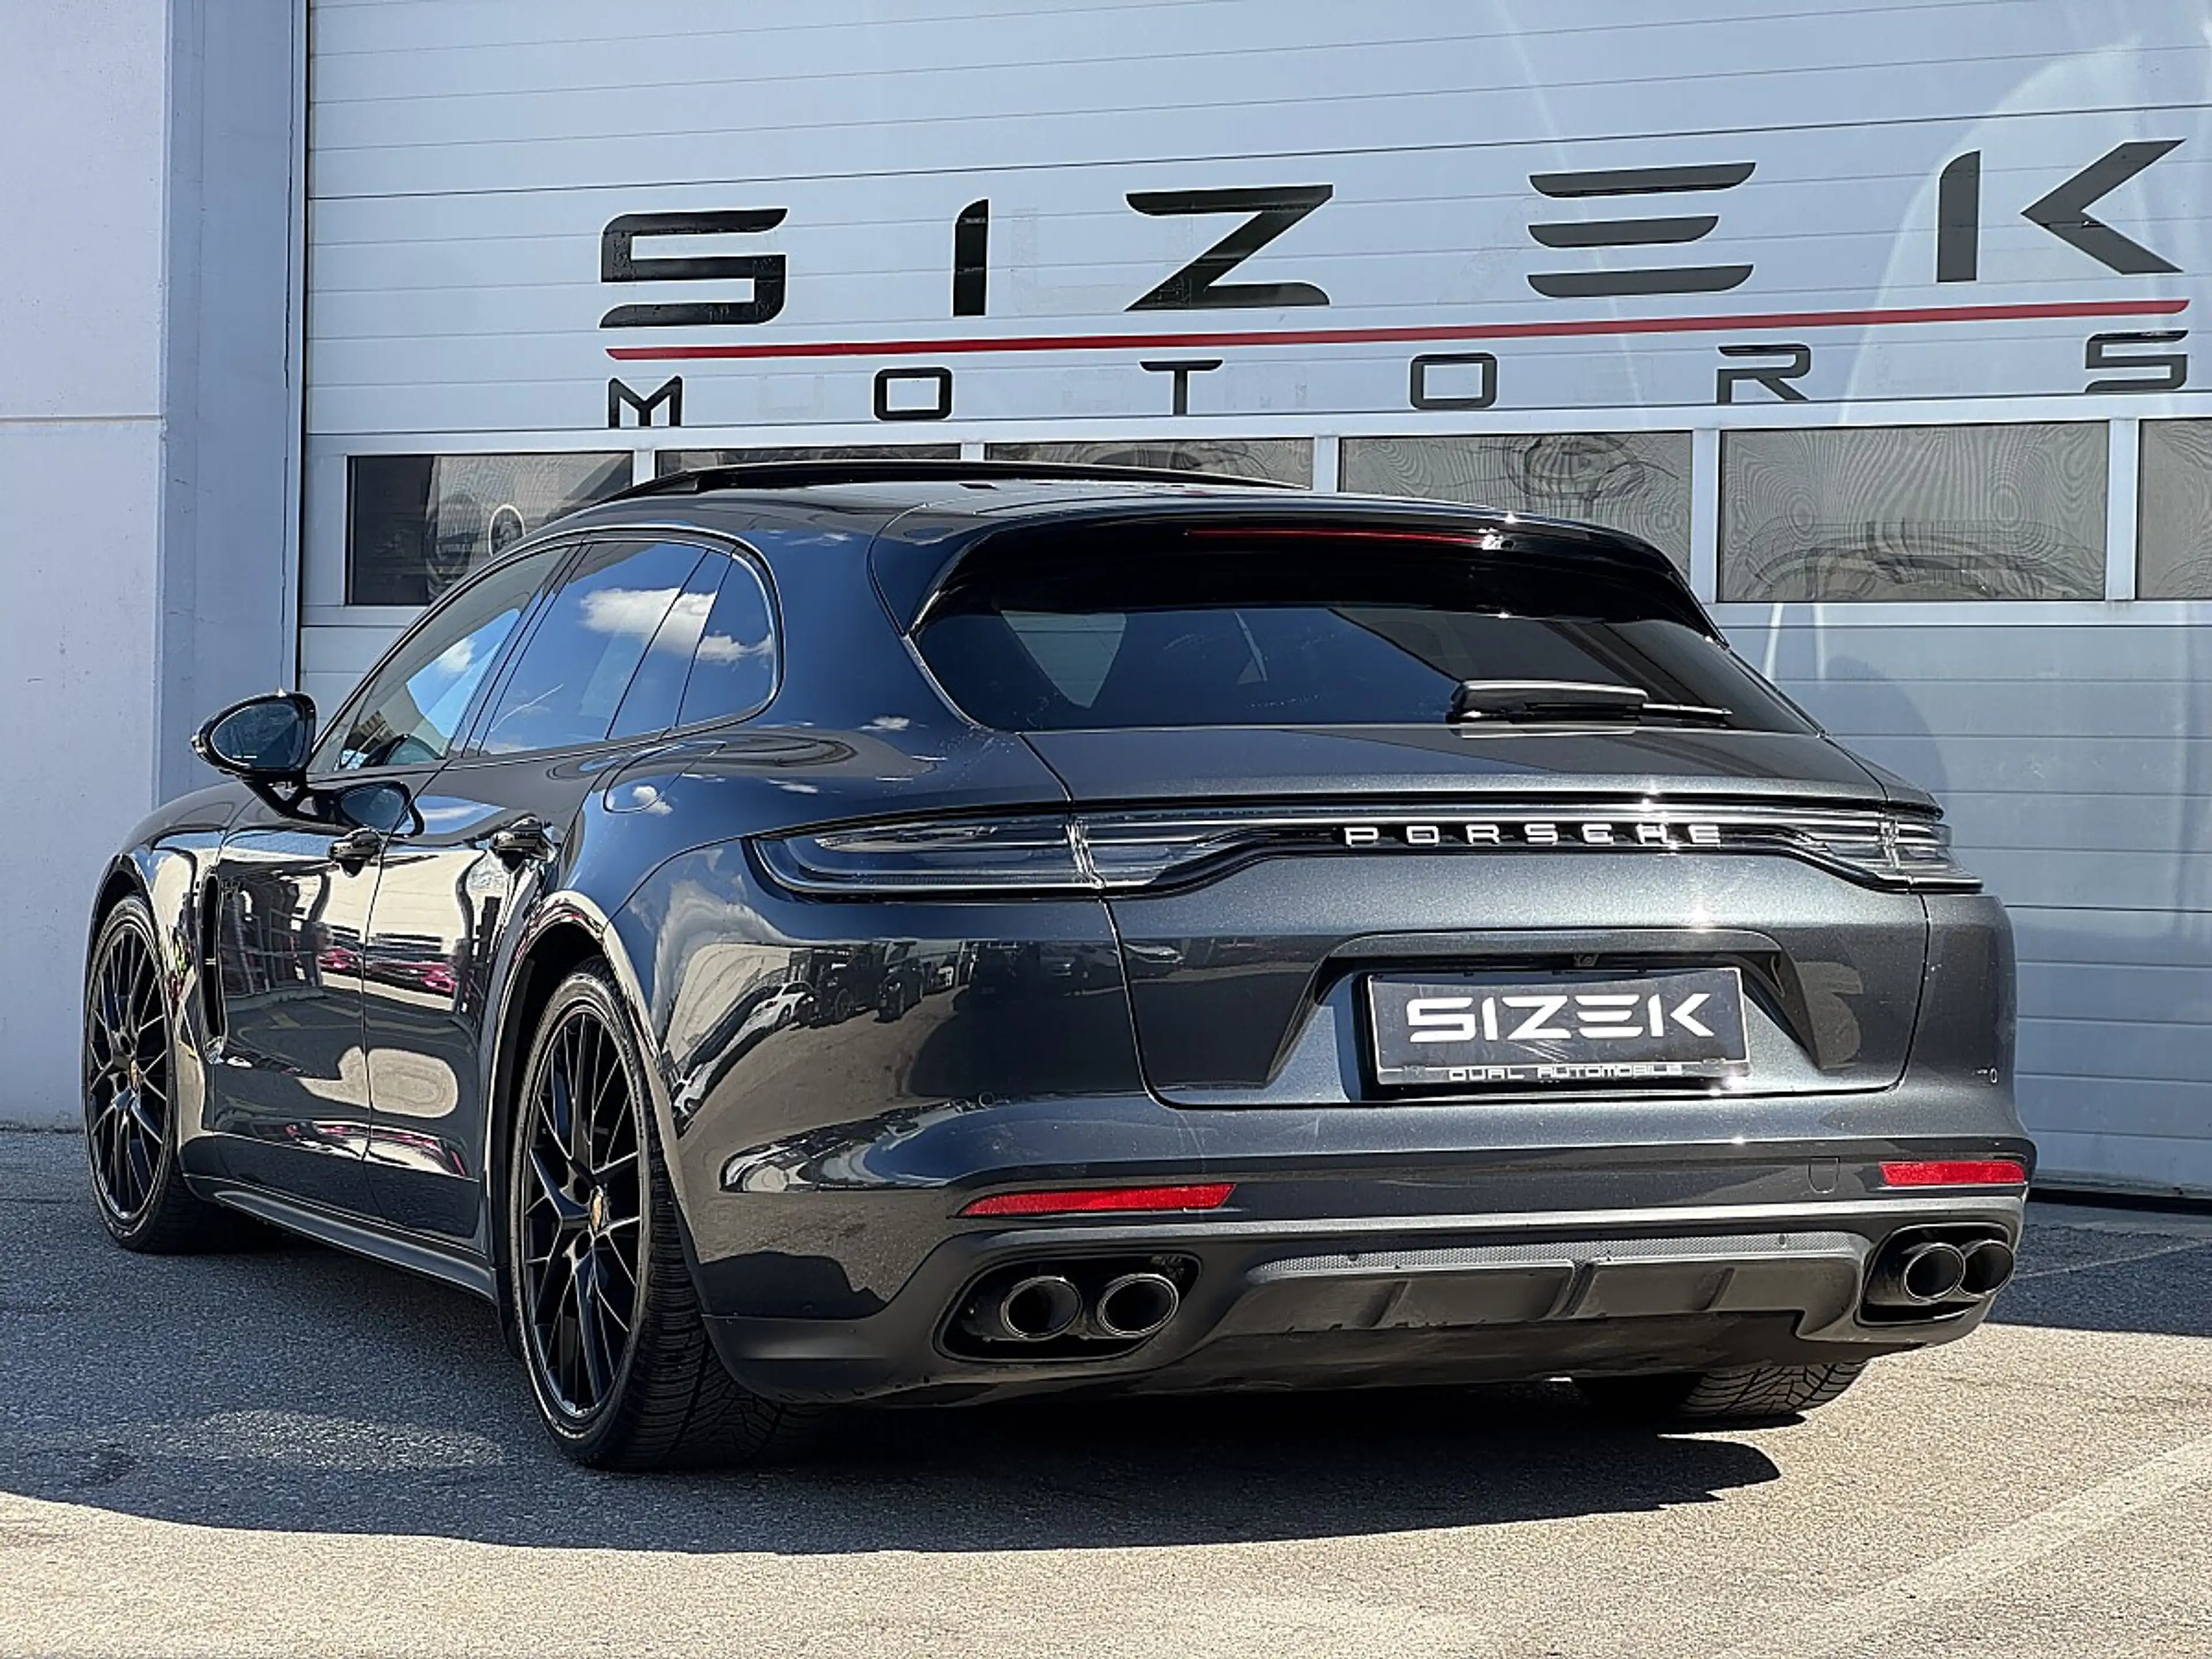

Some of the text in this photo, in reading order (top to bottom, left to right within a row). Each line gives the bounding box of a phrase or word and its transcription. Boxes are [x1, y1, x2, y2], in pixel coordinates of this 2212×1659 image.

[600, 139, 2186, 328] SIZEK
[608, 329, 2188, 428] MOTORS
[1344, 824, 1721, 846] PORSCHE
[1406, 994, 1715, 1042] SIZEK
[1449, 1067, 1525, 1081] DUAL
